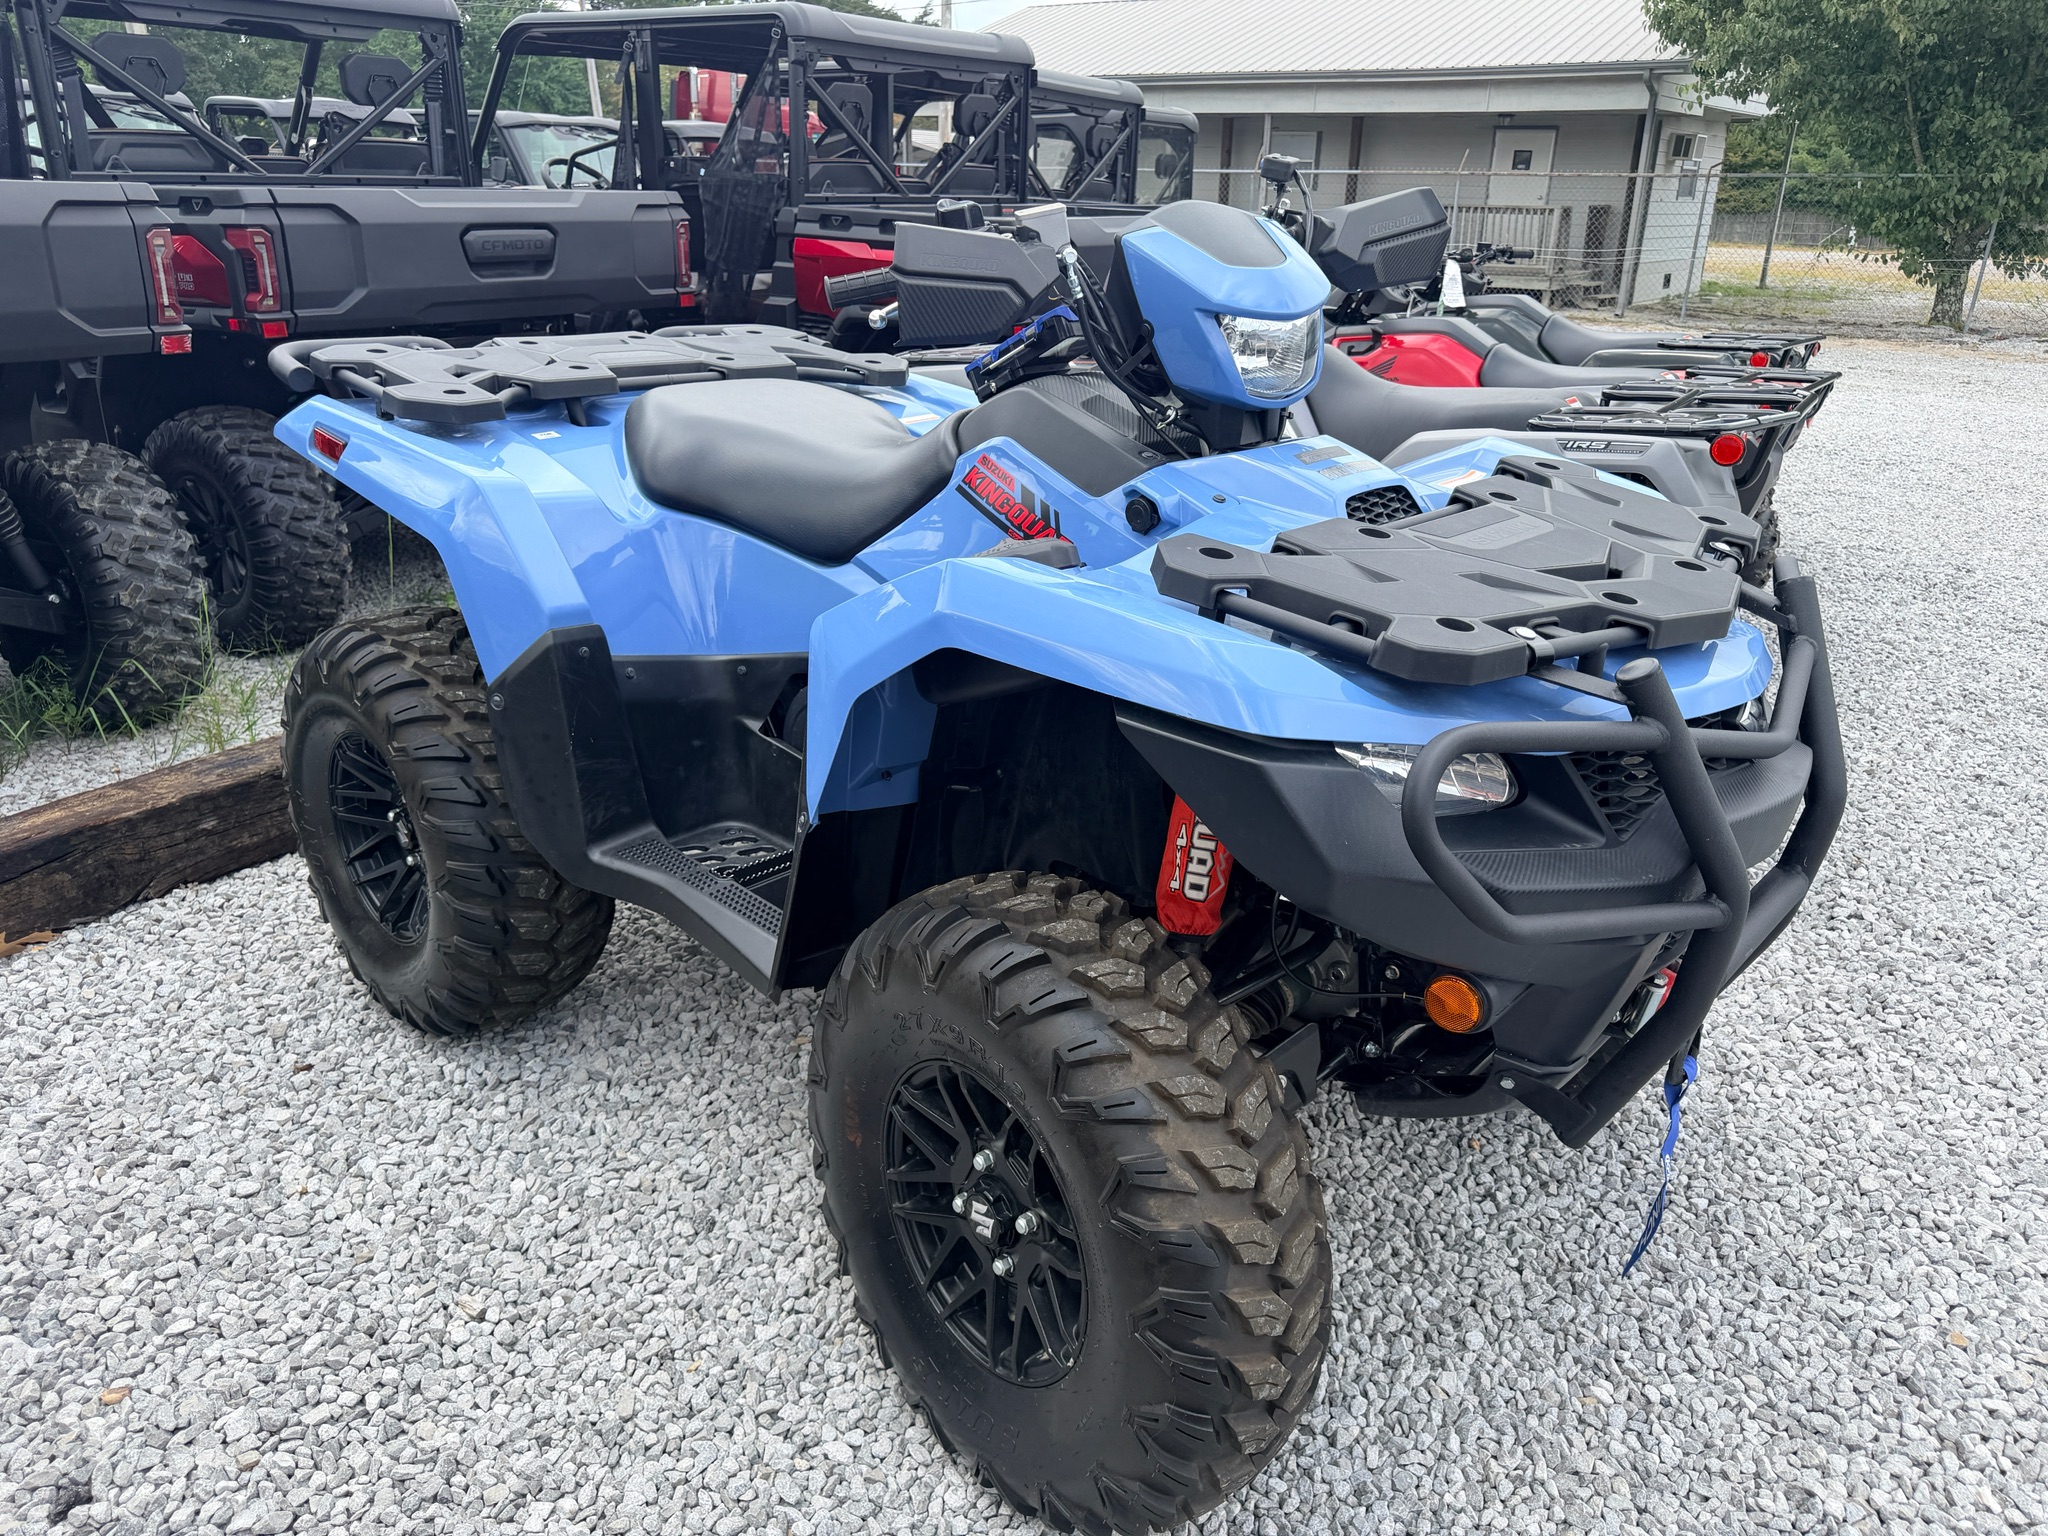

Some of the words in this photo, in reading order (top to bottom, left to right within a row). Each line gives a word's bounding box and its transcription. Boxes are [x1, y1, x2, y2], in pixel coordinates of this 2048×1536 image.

[1368, 213, 1423, 238] KINGQUAD
[481, 239, 545, 251] CFMOTO
[920, 252, 1000, 274] KINGQUAD
[1565, 441, 1609, 449] IRS
[980, 455, 1014, 487] SUZUKI
[963, 465, 1074, 545] KINGQUA
